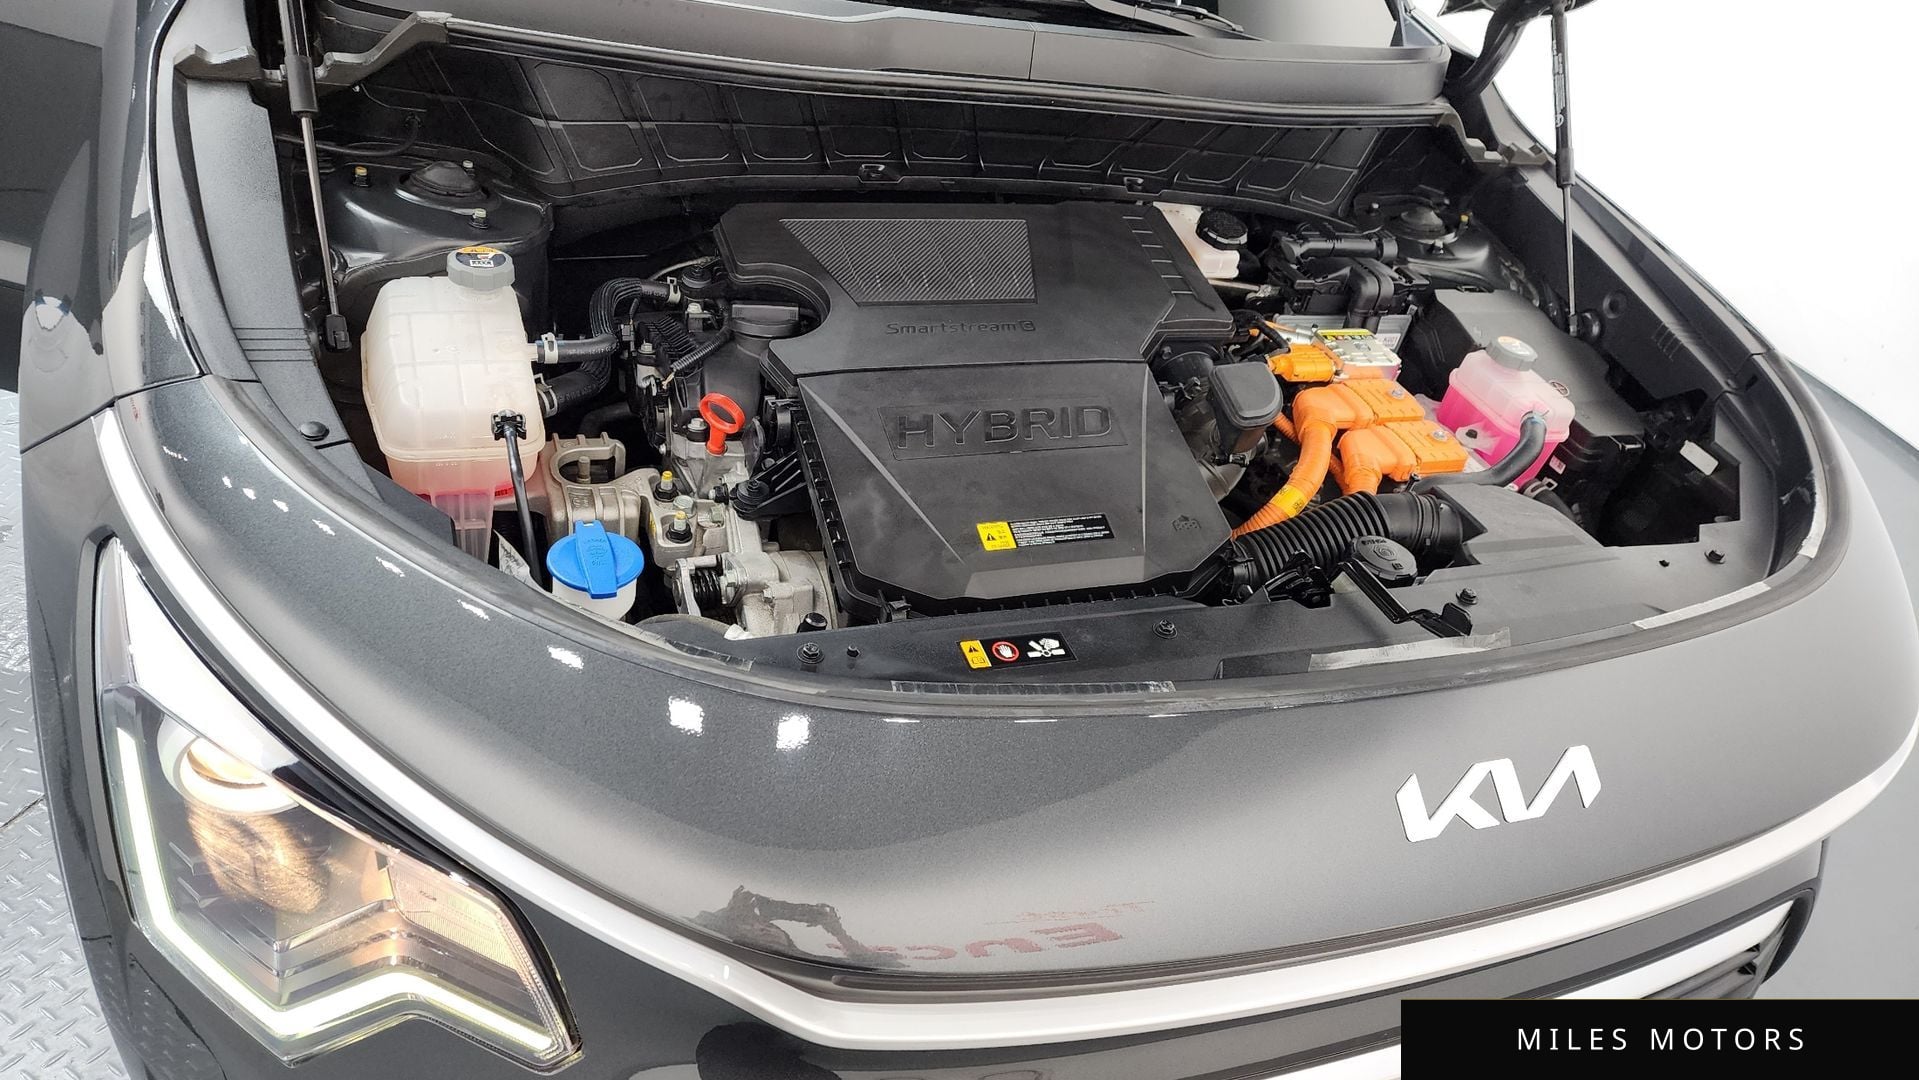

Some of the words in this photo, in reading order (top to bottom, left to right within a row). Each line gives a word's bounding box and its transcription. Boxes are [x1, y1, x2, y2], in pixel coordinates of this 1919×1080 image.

[886, 319, 1017, 335] Smartstream
[897, 406, 1112, 449] HYBRID
[1396, 744, 1602, 843] KIA
